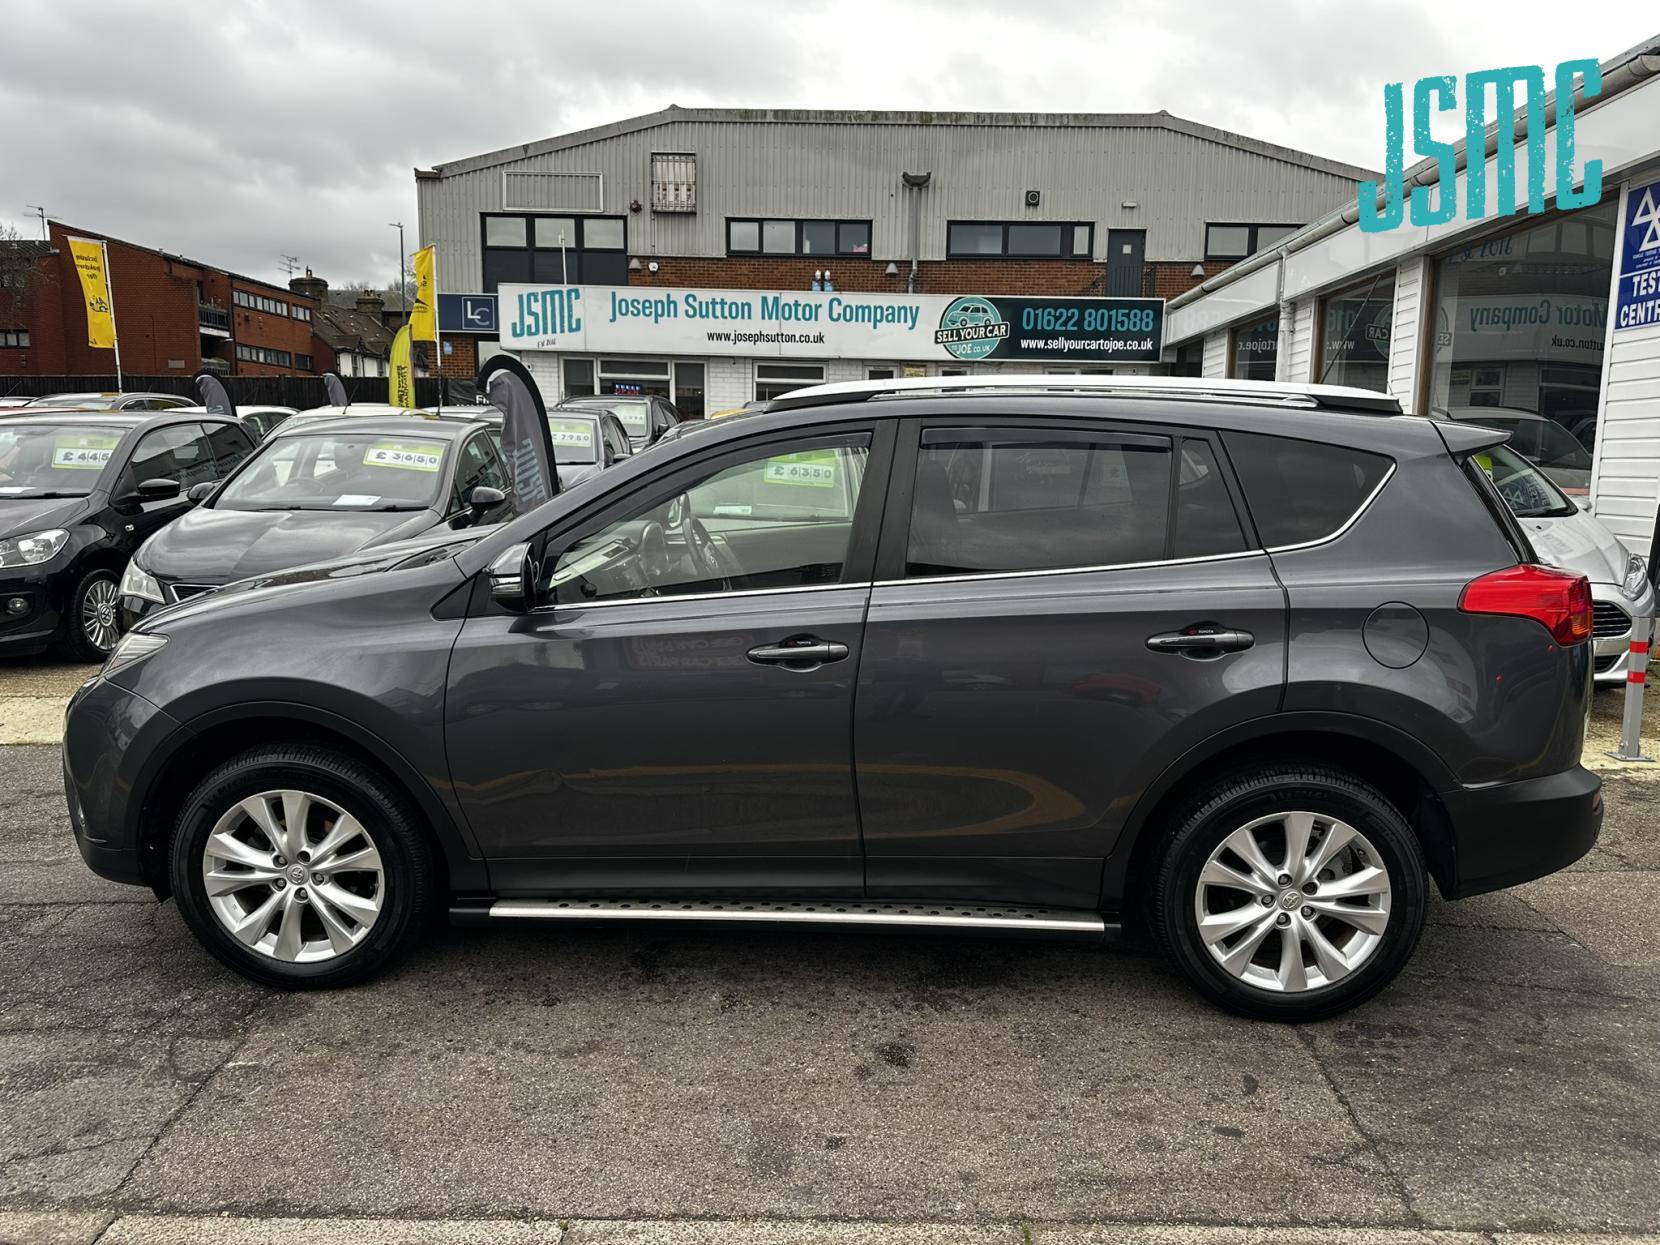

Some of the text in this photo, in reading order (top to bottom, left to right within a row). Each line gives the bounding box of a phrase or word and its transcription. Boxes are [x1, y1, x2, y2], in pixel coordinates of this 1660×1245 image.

[512, 287, 582, 338] JSMC
[609, 291, 920, 330] Joseph Sutton Motor Company
[1022, 307, 1154, 332] 01622 801588
[707, 329, 825, 345] www.josephsutton.co.uk
[936, 325, 1007, 343] SELL YOUR CAR
[957, 343, 972, 354] JOE
[1020, 336, 1153, 353] www.sellyourcartojoe.co.uk
